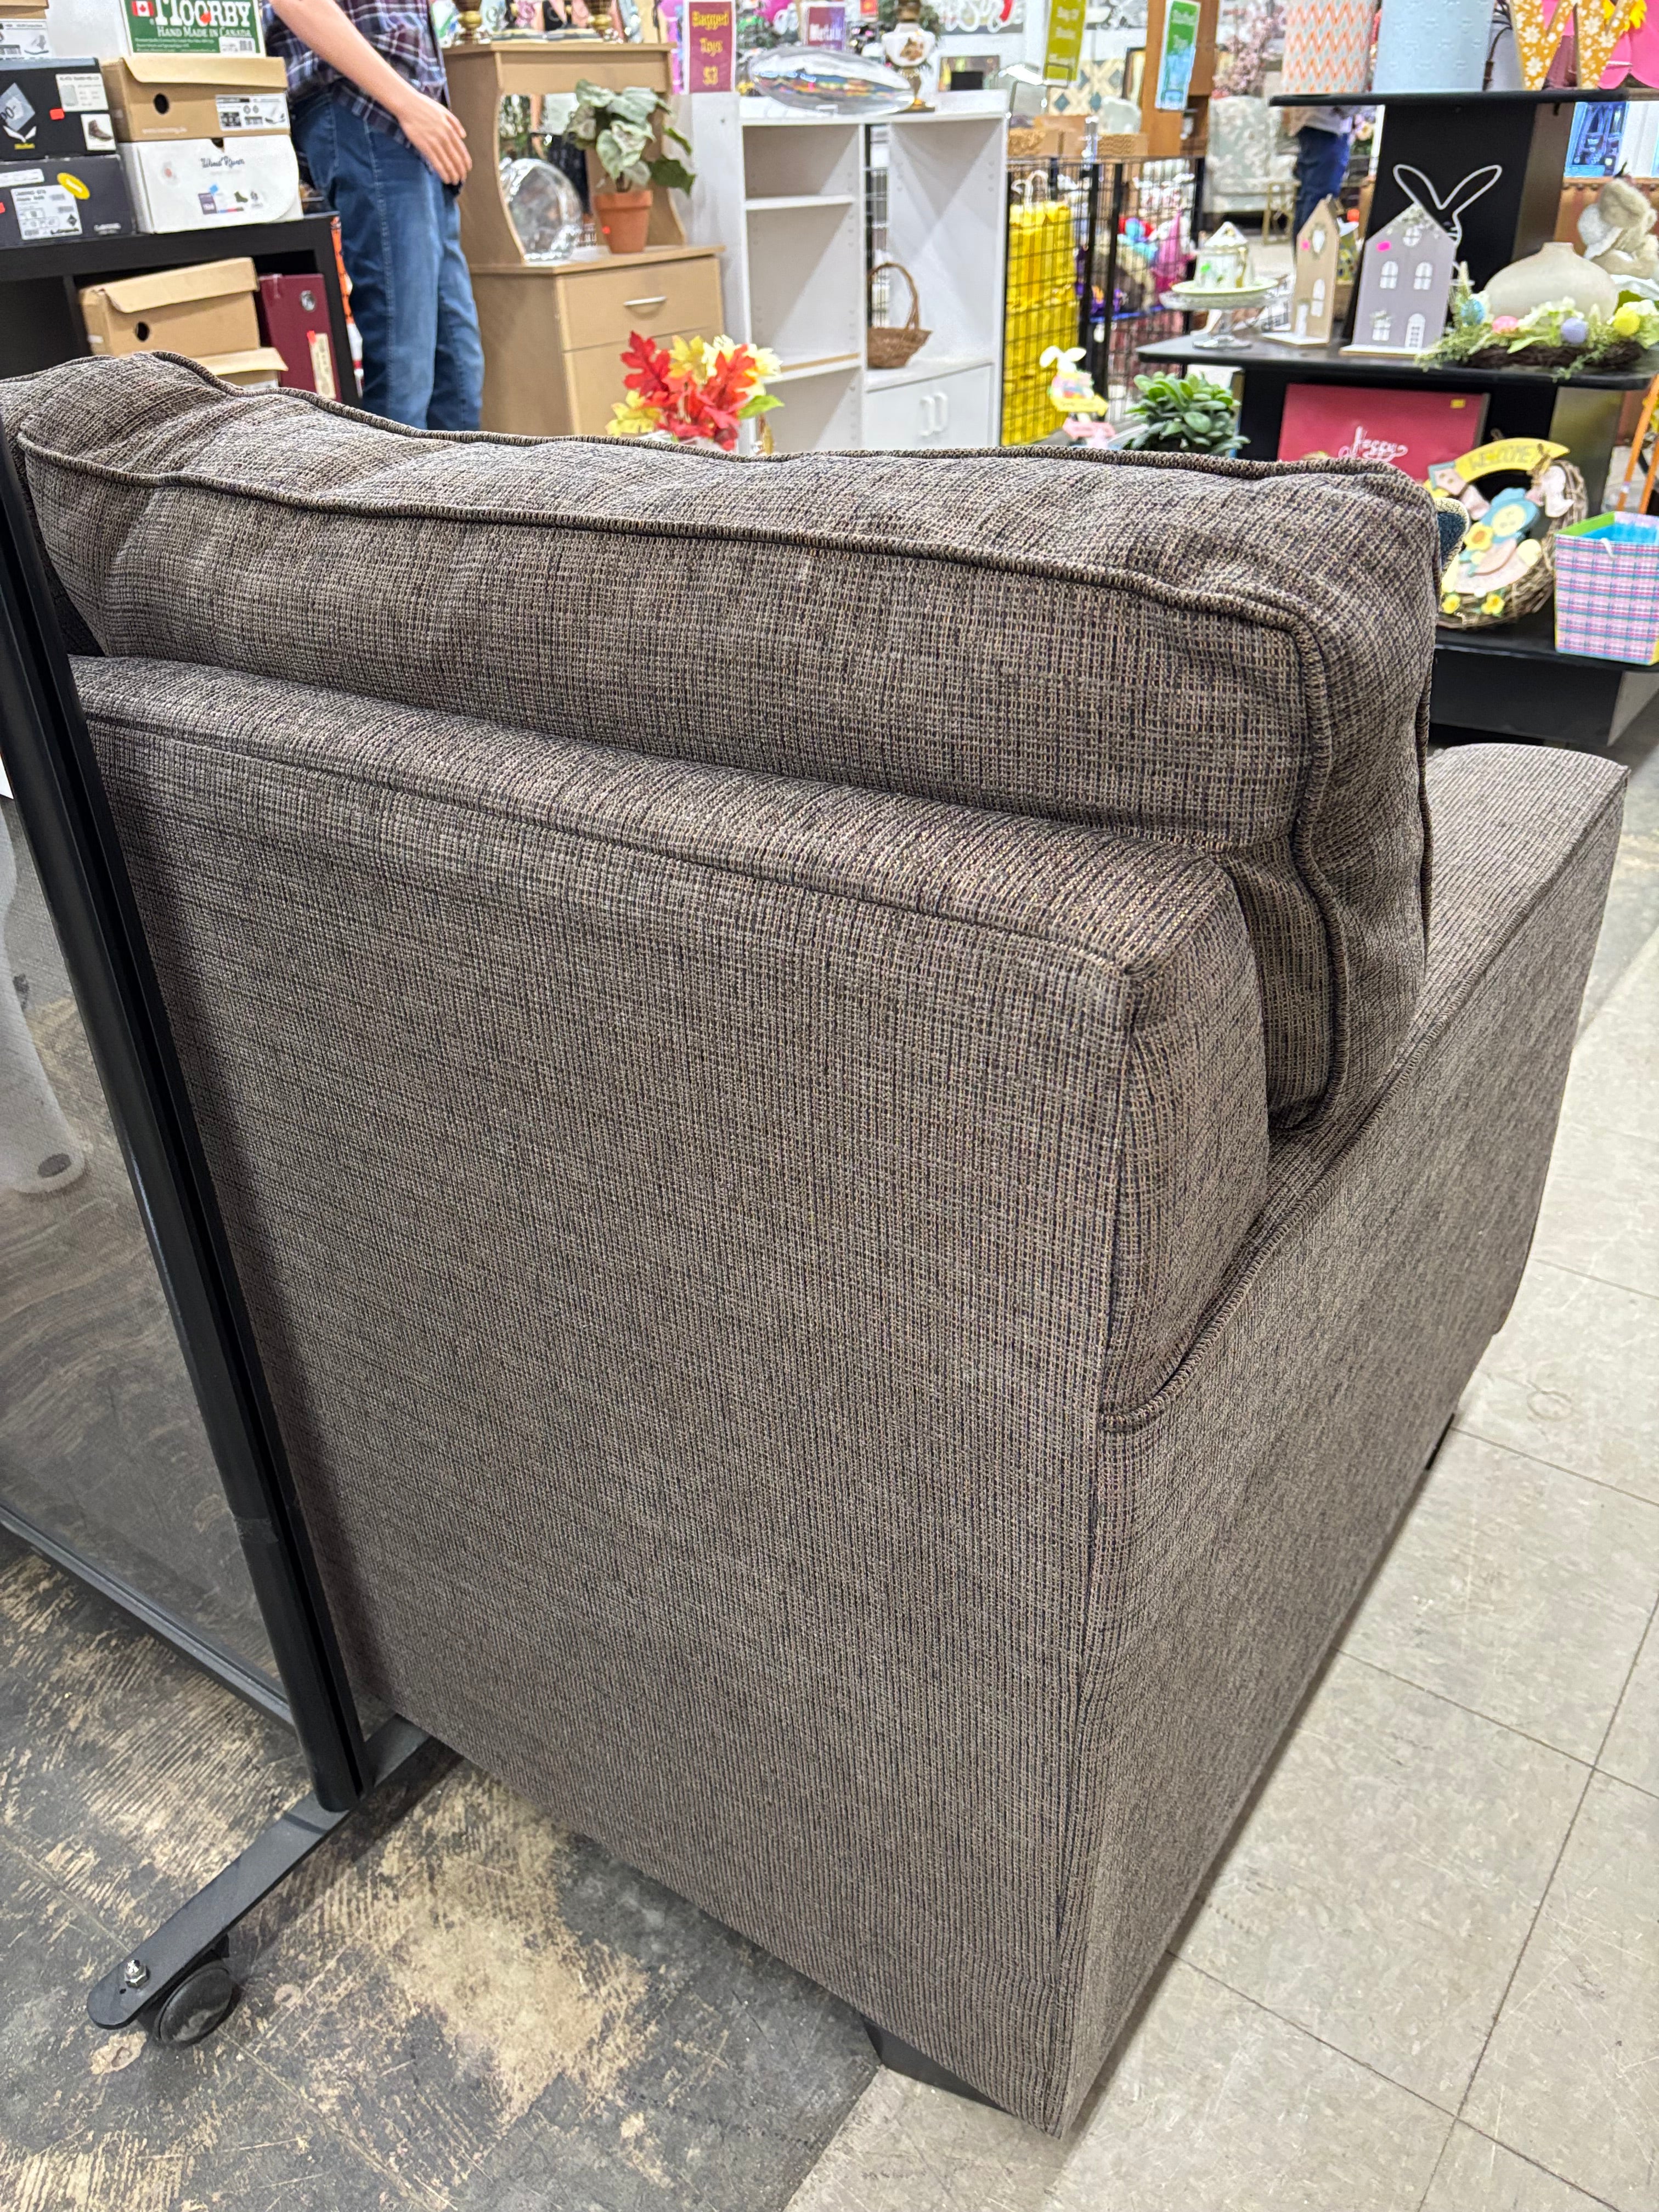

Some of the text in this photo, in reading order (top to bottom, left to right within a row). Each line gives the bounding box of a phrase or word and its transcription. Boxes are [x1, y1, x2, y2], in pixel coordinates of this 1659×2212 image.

[157, 26, 182, 37] HAND
[183, 27, 208, 37] MADE
[699, 37, 723, 57] Toys
